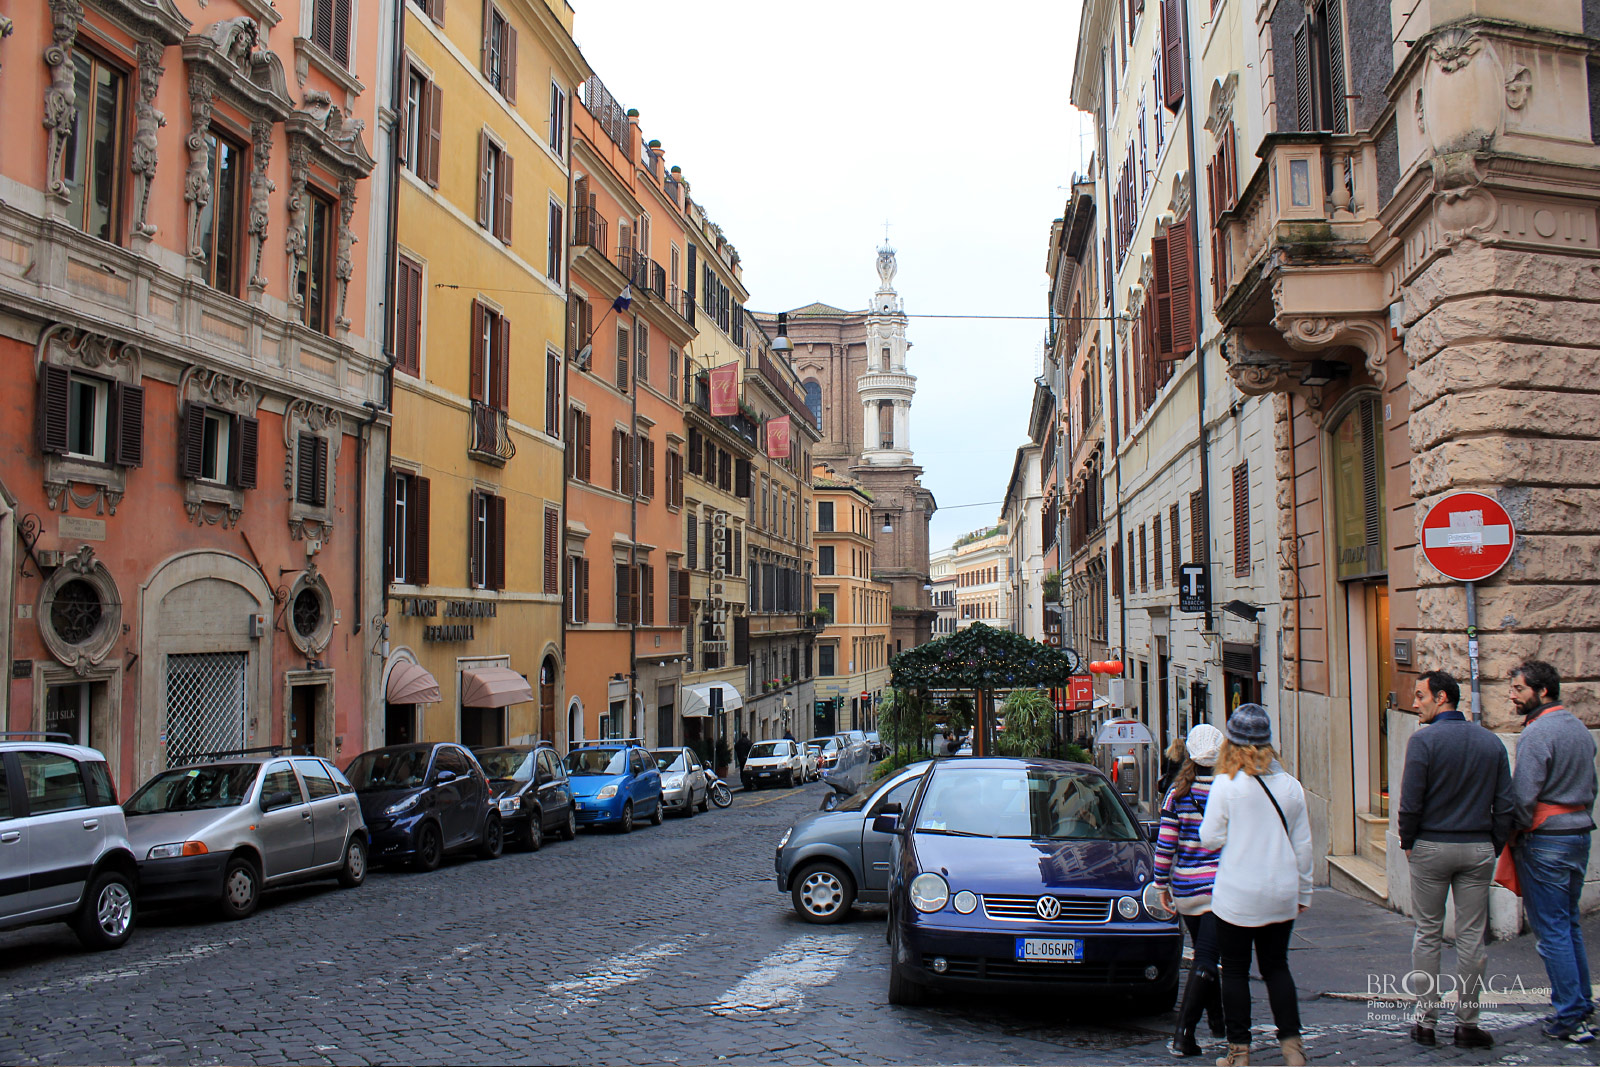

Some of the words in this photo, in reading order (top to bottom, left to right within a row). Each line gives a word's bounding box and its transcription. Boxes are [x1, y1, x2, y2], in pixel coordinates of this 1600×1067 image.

[714, 514, 725, 636] CONCORDIA
[1183, 567, 1203, 596] T
[401, 599, 437, 617] LAVORI
[446, 601, 497, 618] ARTIGIANALI
[424, 625, 475, 641] FEMMINILI
[702, 642, 729, 652] HOTEL
[60, 709, 75, 719] SILK
